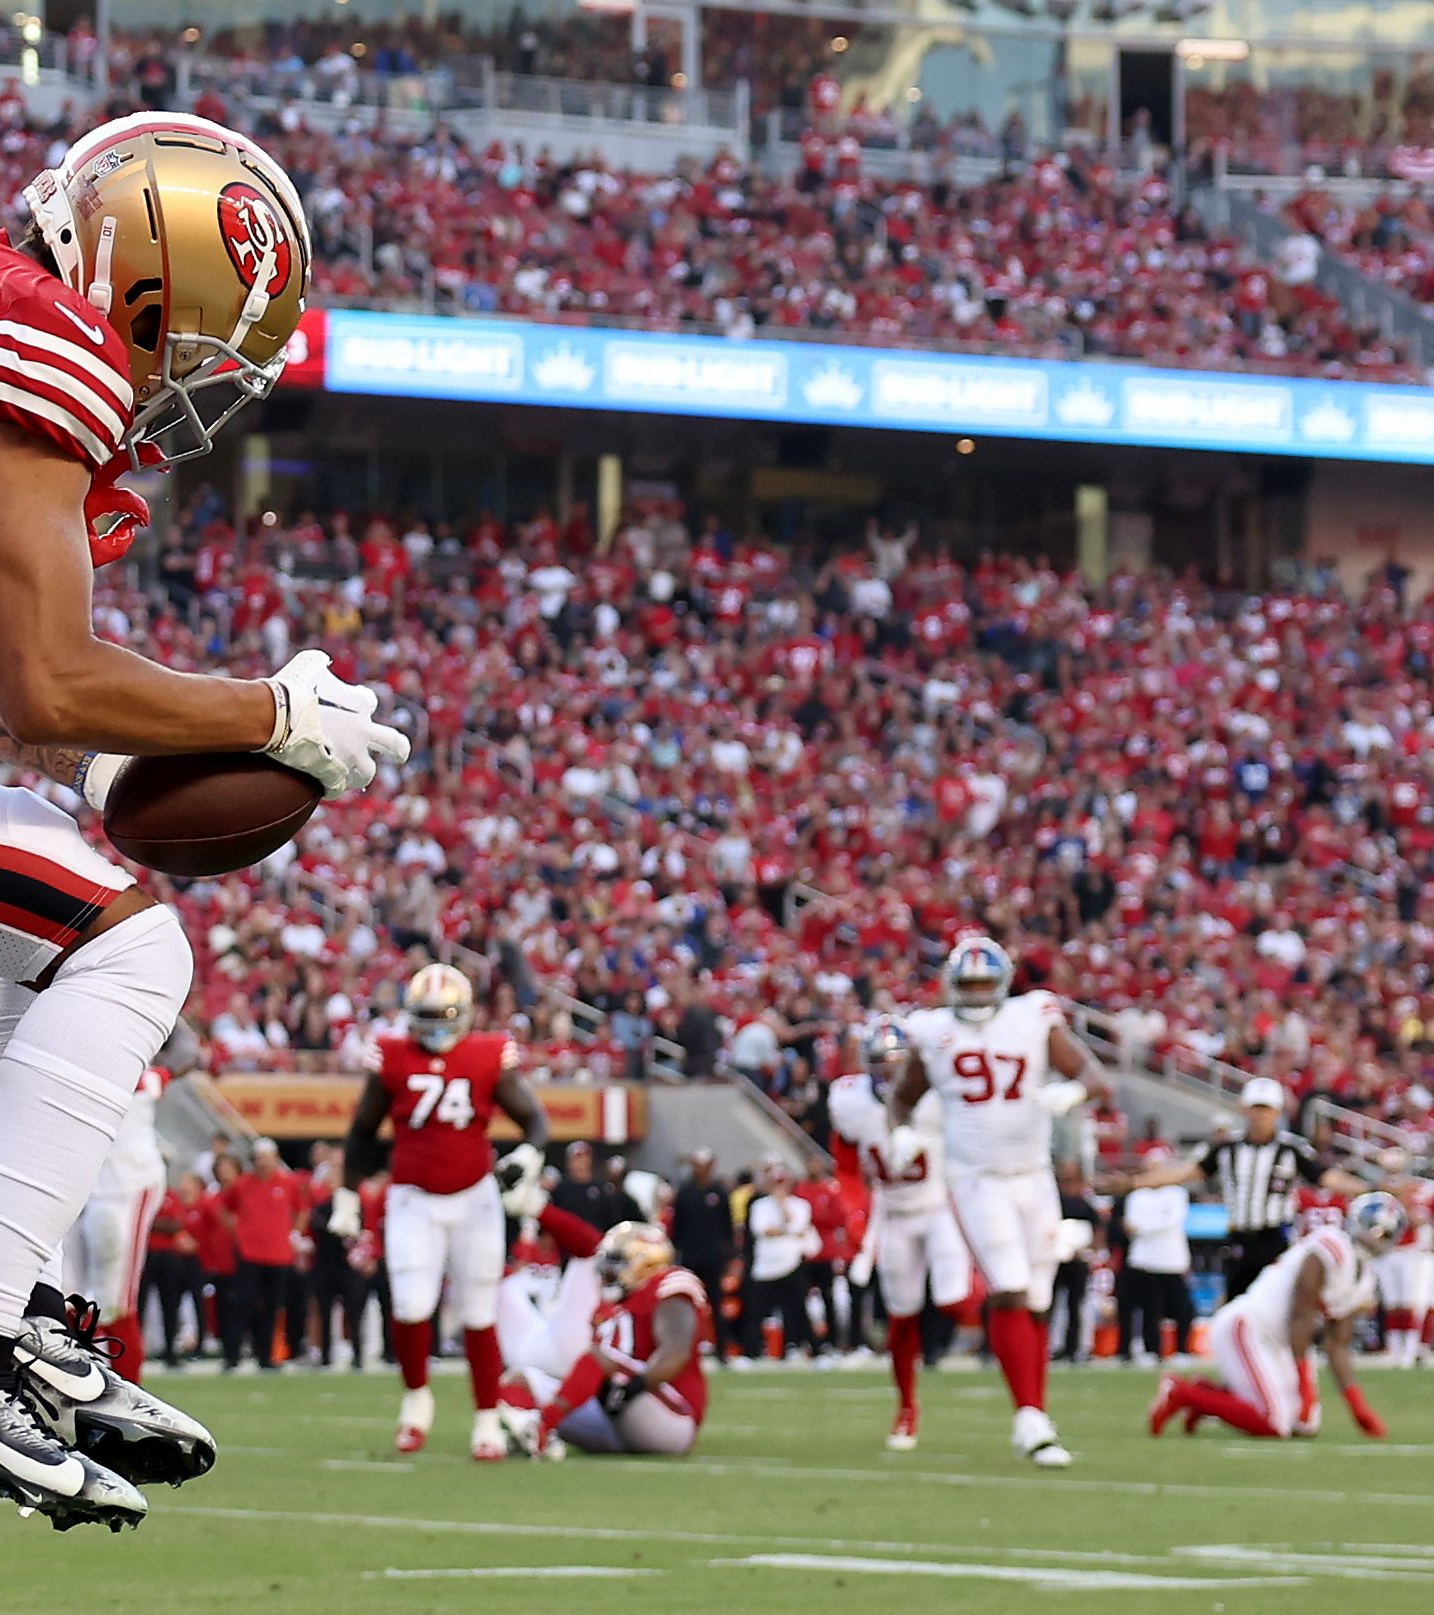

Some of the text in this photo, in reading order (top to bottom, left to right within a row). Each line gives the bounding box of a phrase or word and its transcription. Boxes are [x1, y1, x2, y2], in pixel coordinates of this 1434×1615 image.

[344, 335, 412, 370] BUD
[417, 340, 510, 376] LIGHT
[614, 353, 774, 393] BUD LIGHT
[954, 1050, 1026, 1103] 97
[407, 1073, 475, 1130] 74
